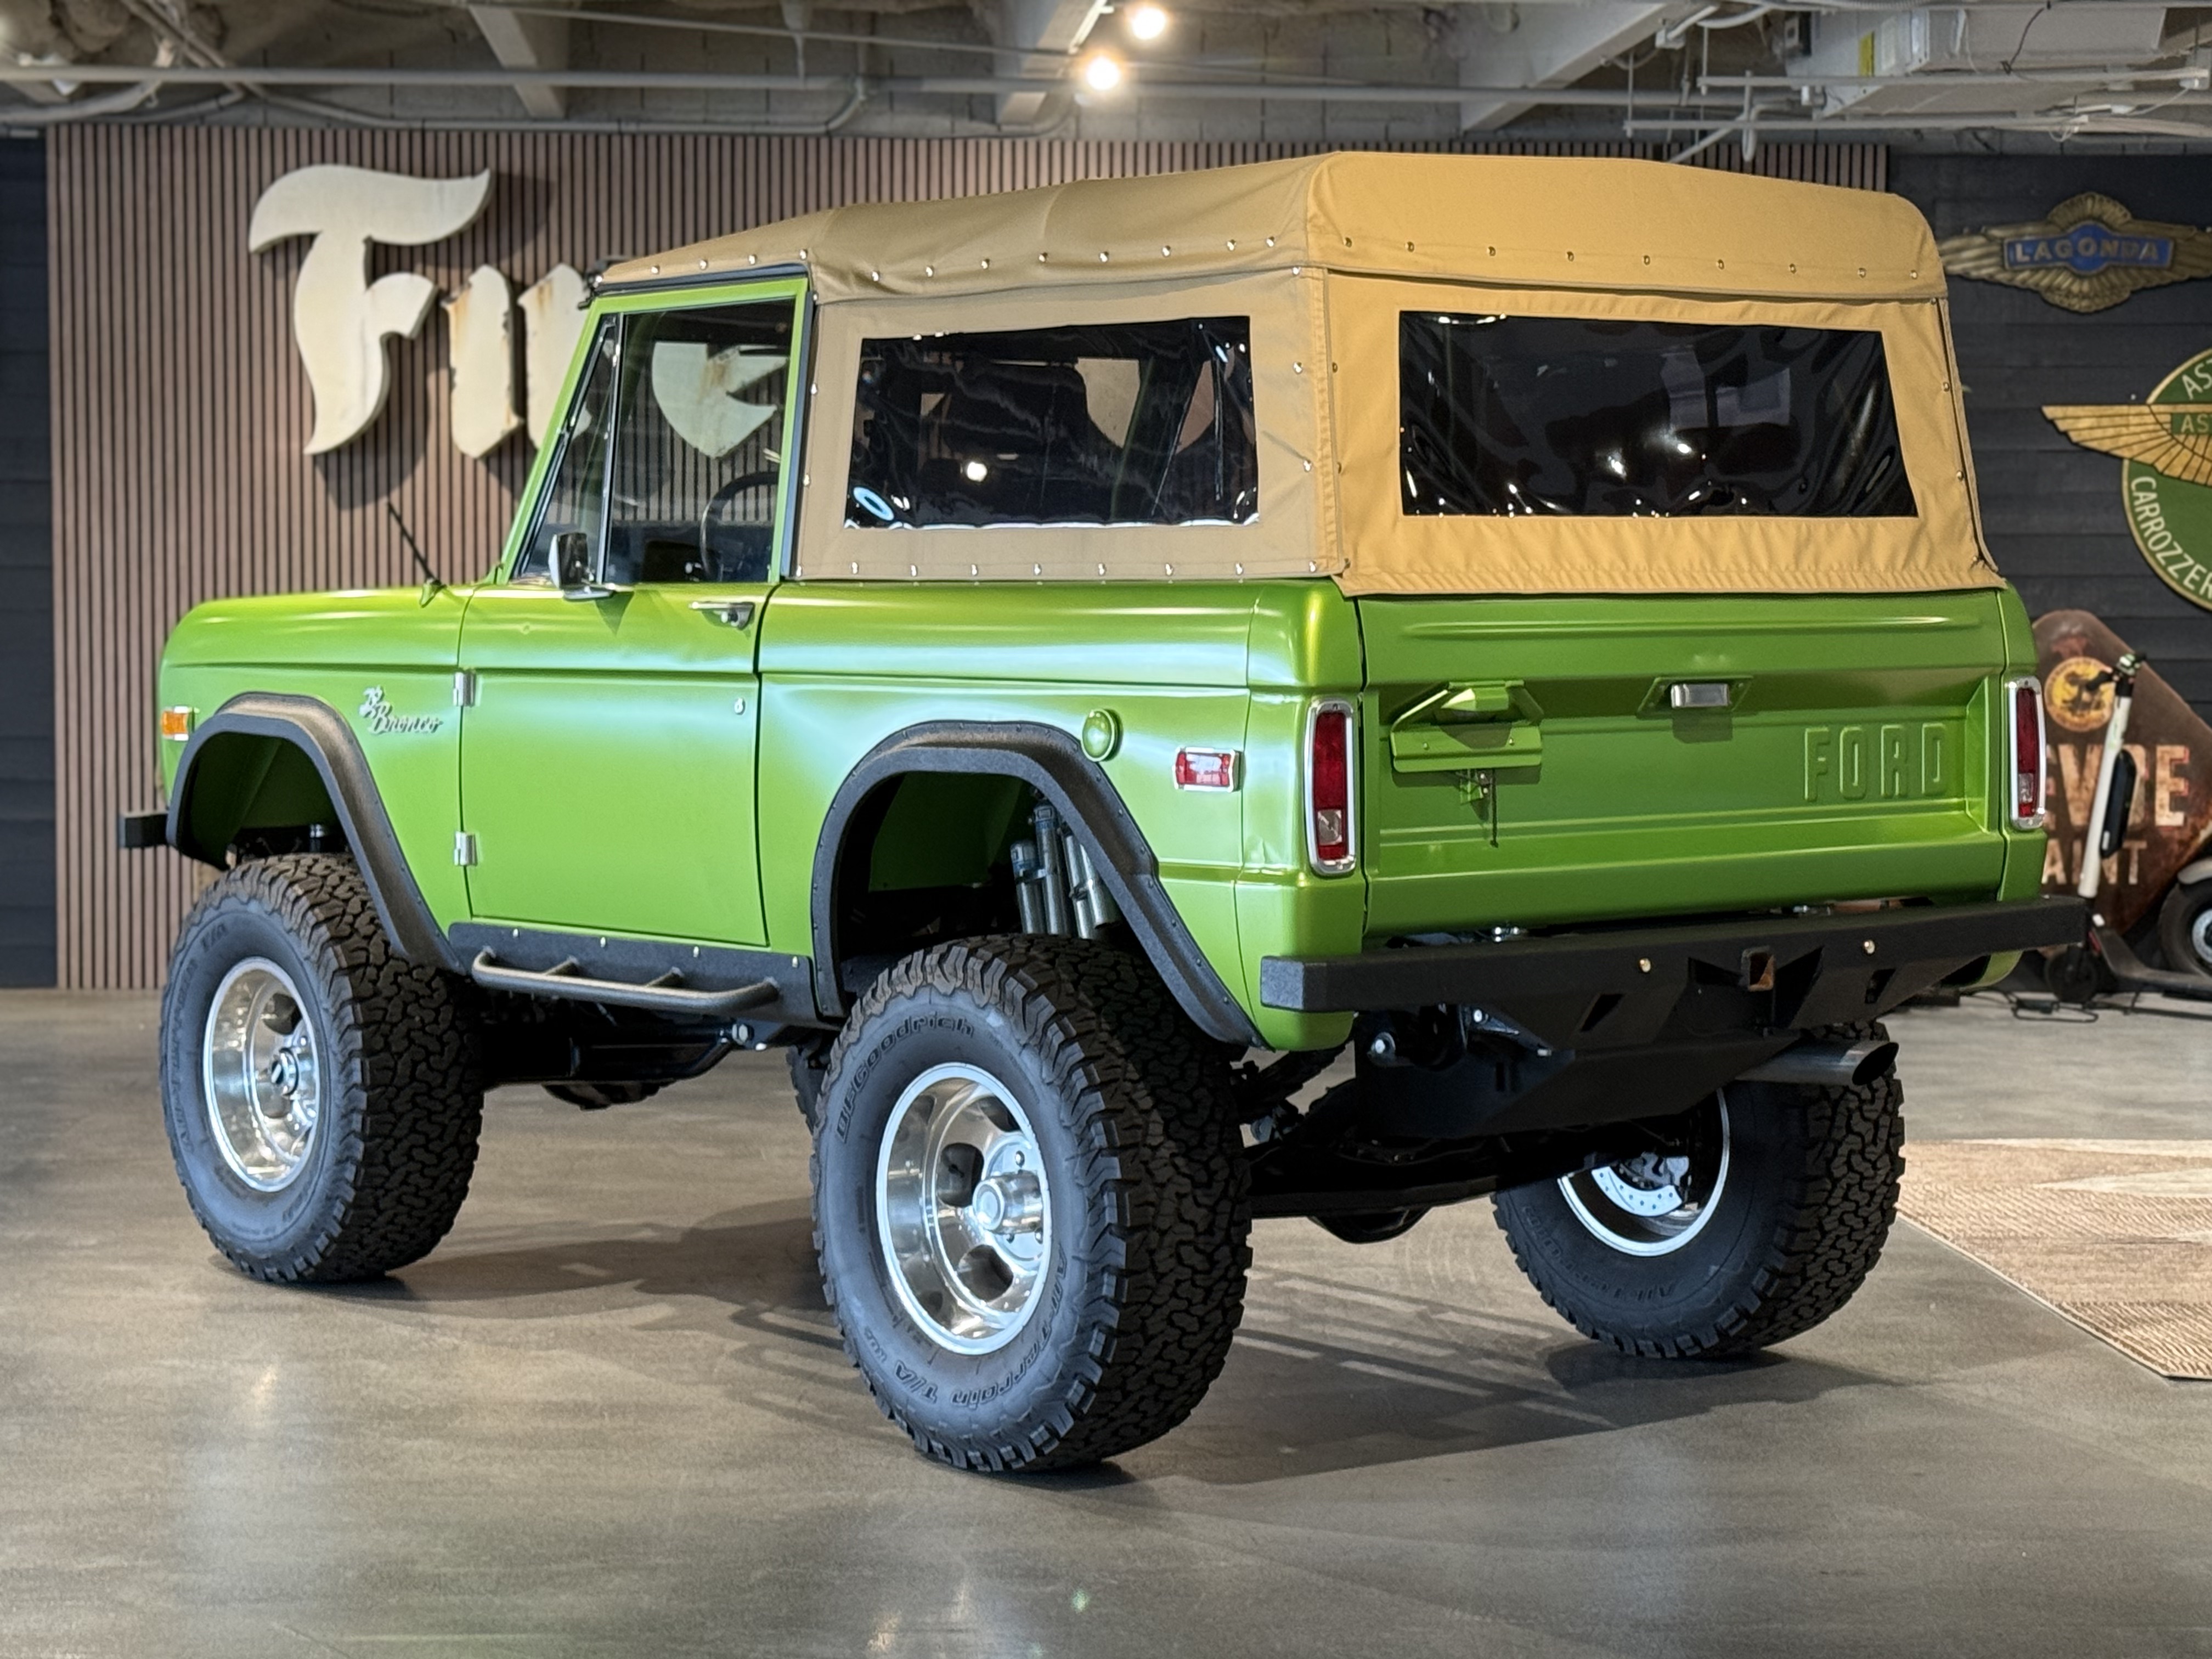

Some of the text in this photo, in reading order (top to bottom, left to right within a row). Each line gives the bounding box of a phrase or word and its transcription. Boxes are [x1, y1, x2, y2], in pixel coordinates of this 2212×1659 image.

[2015, 238, 2158, 262] LAGONDA
[366, 701, 444, 735] Bronco
[1804, 722, 1947, 802] FORD
[837, 1012, 975, 1144] BFGoodrich
[951, 1244, 1068, 1409] All-Terrain
[894, 1359, 939, 1404] T/A
